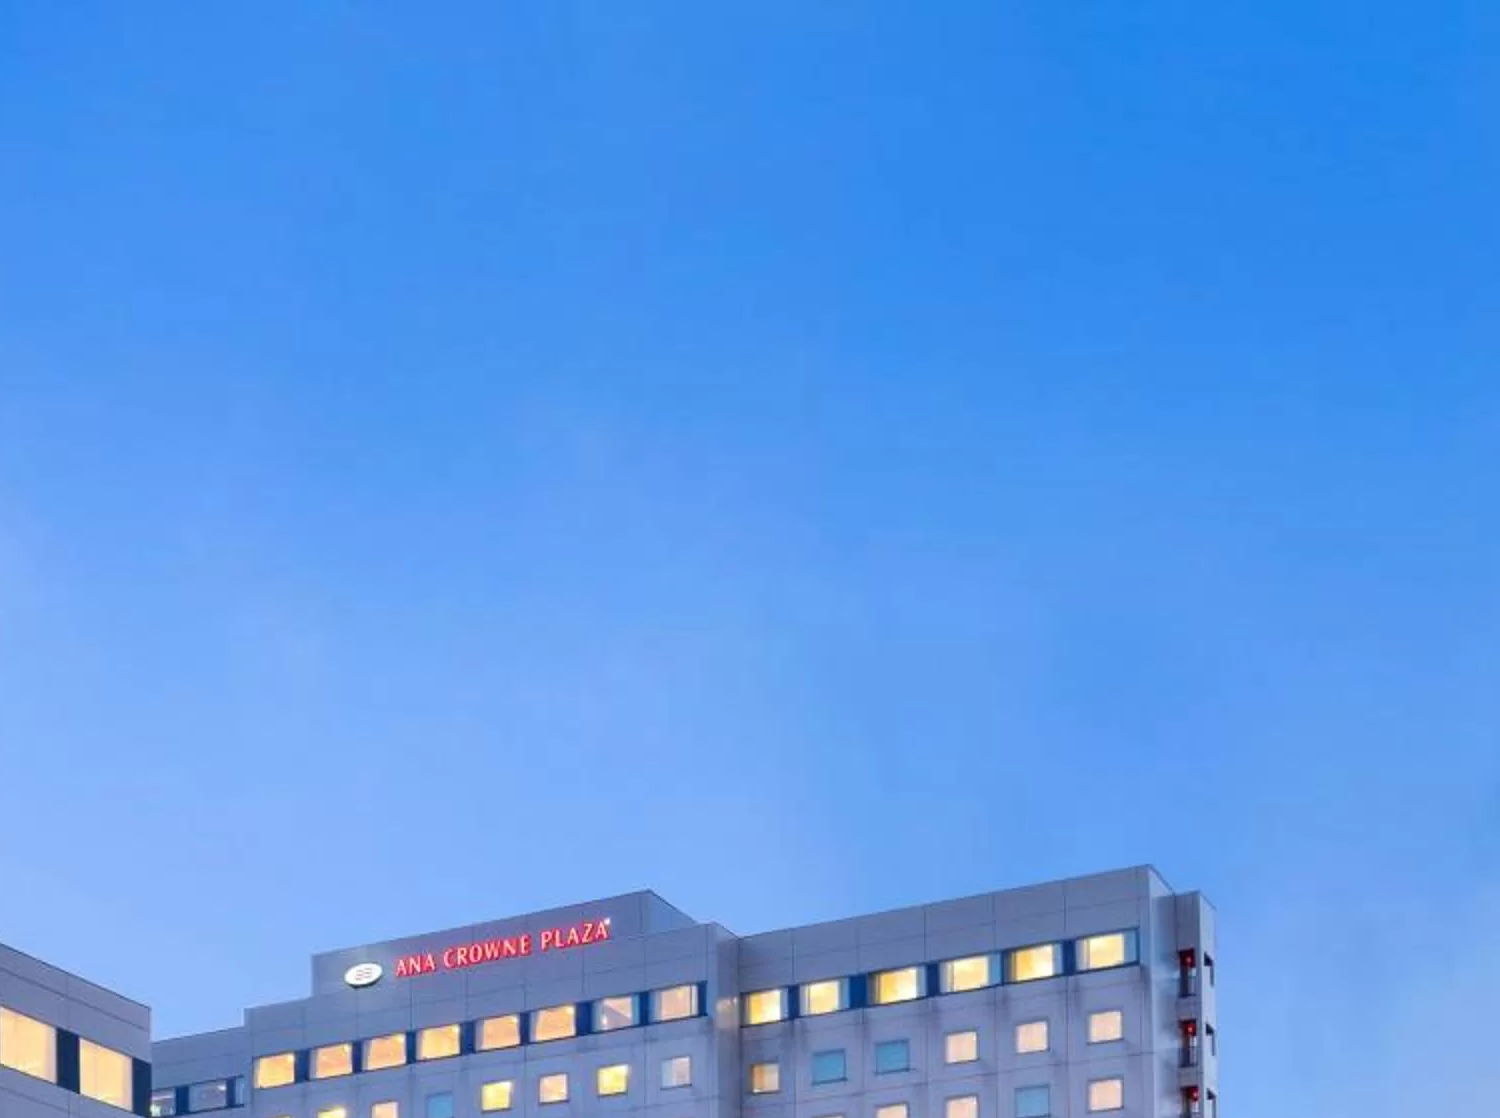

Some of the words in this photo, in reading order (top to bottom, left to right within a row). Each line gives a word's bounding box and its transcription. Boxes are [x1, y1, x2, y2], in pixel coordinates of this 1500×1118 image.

[395, 955, 436, 977] ANA
[443, 935, 531, 968] CROWNE
[540, 920, 610, 951] PLAZA
